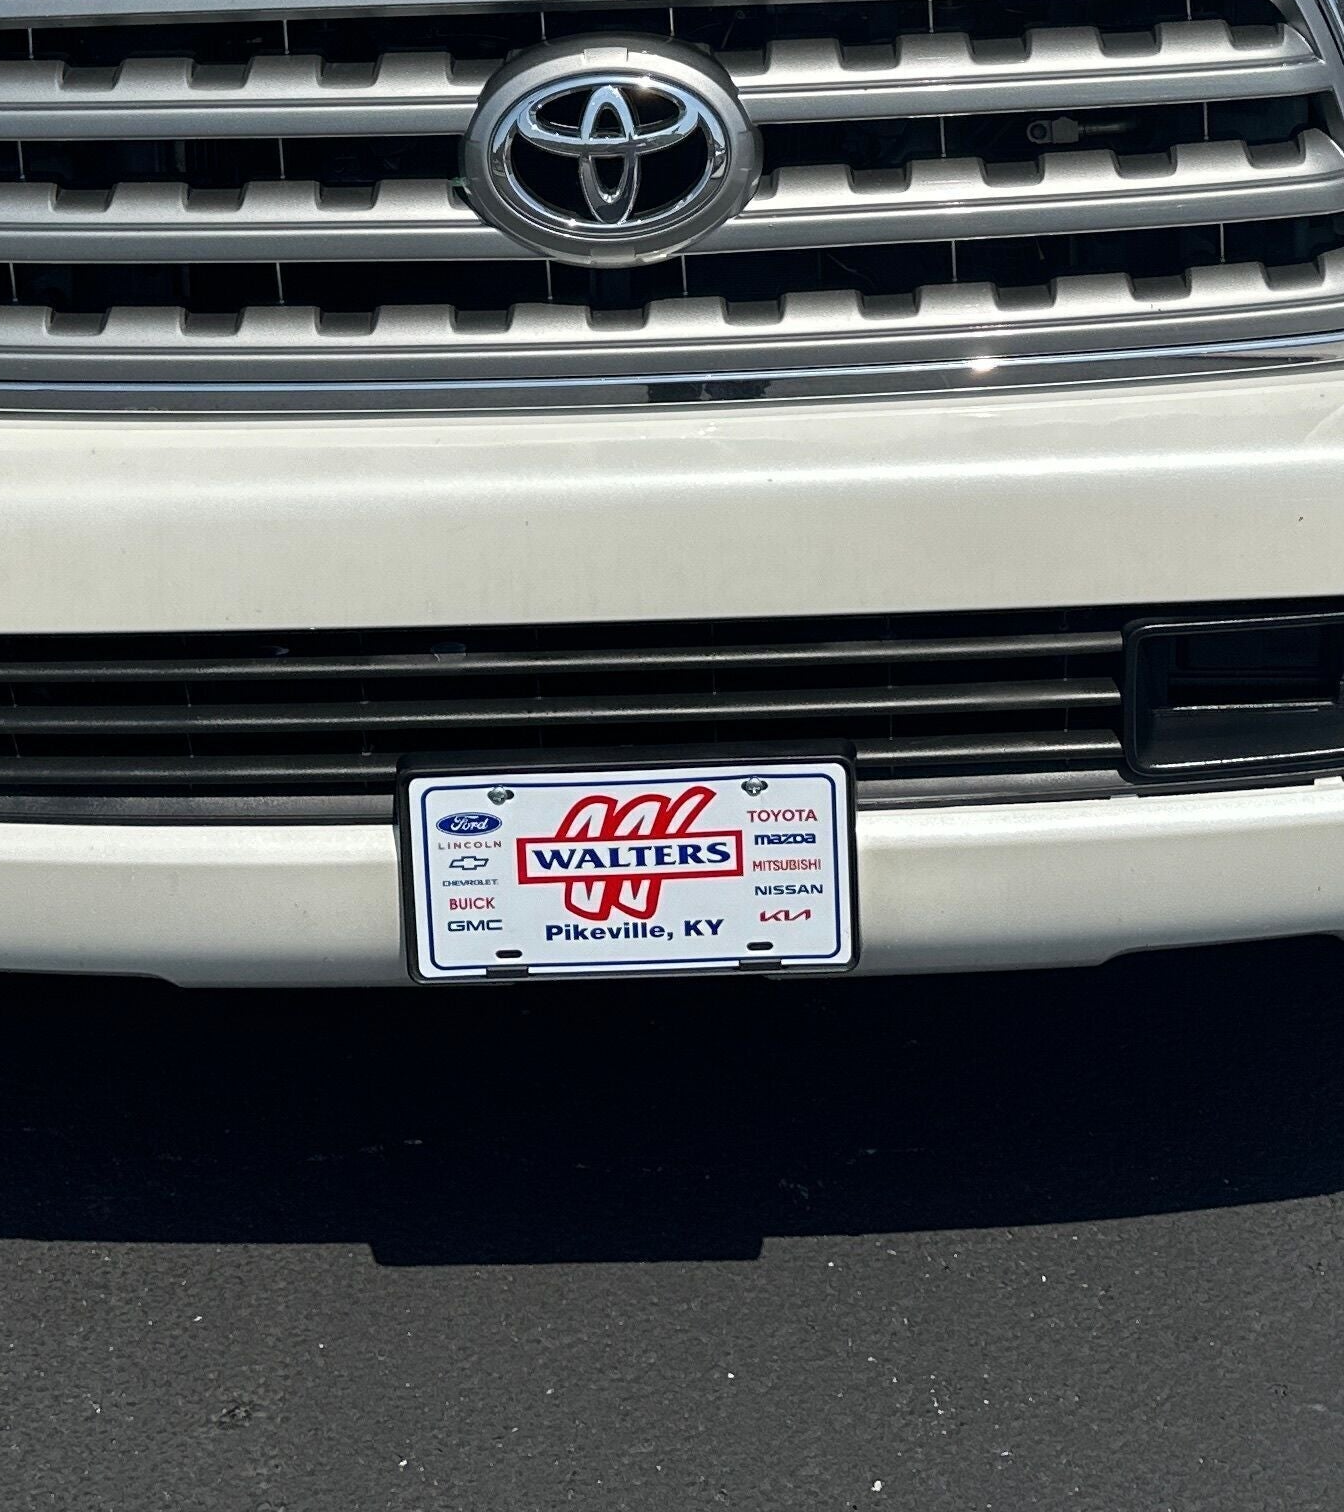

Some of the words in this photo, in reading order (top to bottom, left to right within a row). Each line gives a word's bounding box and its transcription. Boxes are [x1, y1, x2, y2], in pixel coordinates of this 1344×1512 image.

[747, 809, 818, 823] TOYOTA
[451, 815, 489, 831] Ford
[438, 840, 502, 850] LINCOLN
[754, 833, 816, 845] mazda
[532, 842, 731, 870] WALTERS
[752, 858, 822, 872] MITSUBISHI
[442, 878, 499, 887] CHEVROLET
[754, 884, 824, 896] NISSAN
[449, 897, 496, 910] BUICK
[447, 919, 503, 932] GMC
[545, 922, 674, 941] Pikeville,
[683, 918, 725, 937] KY
